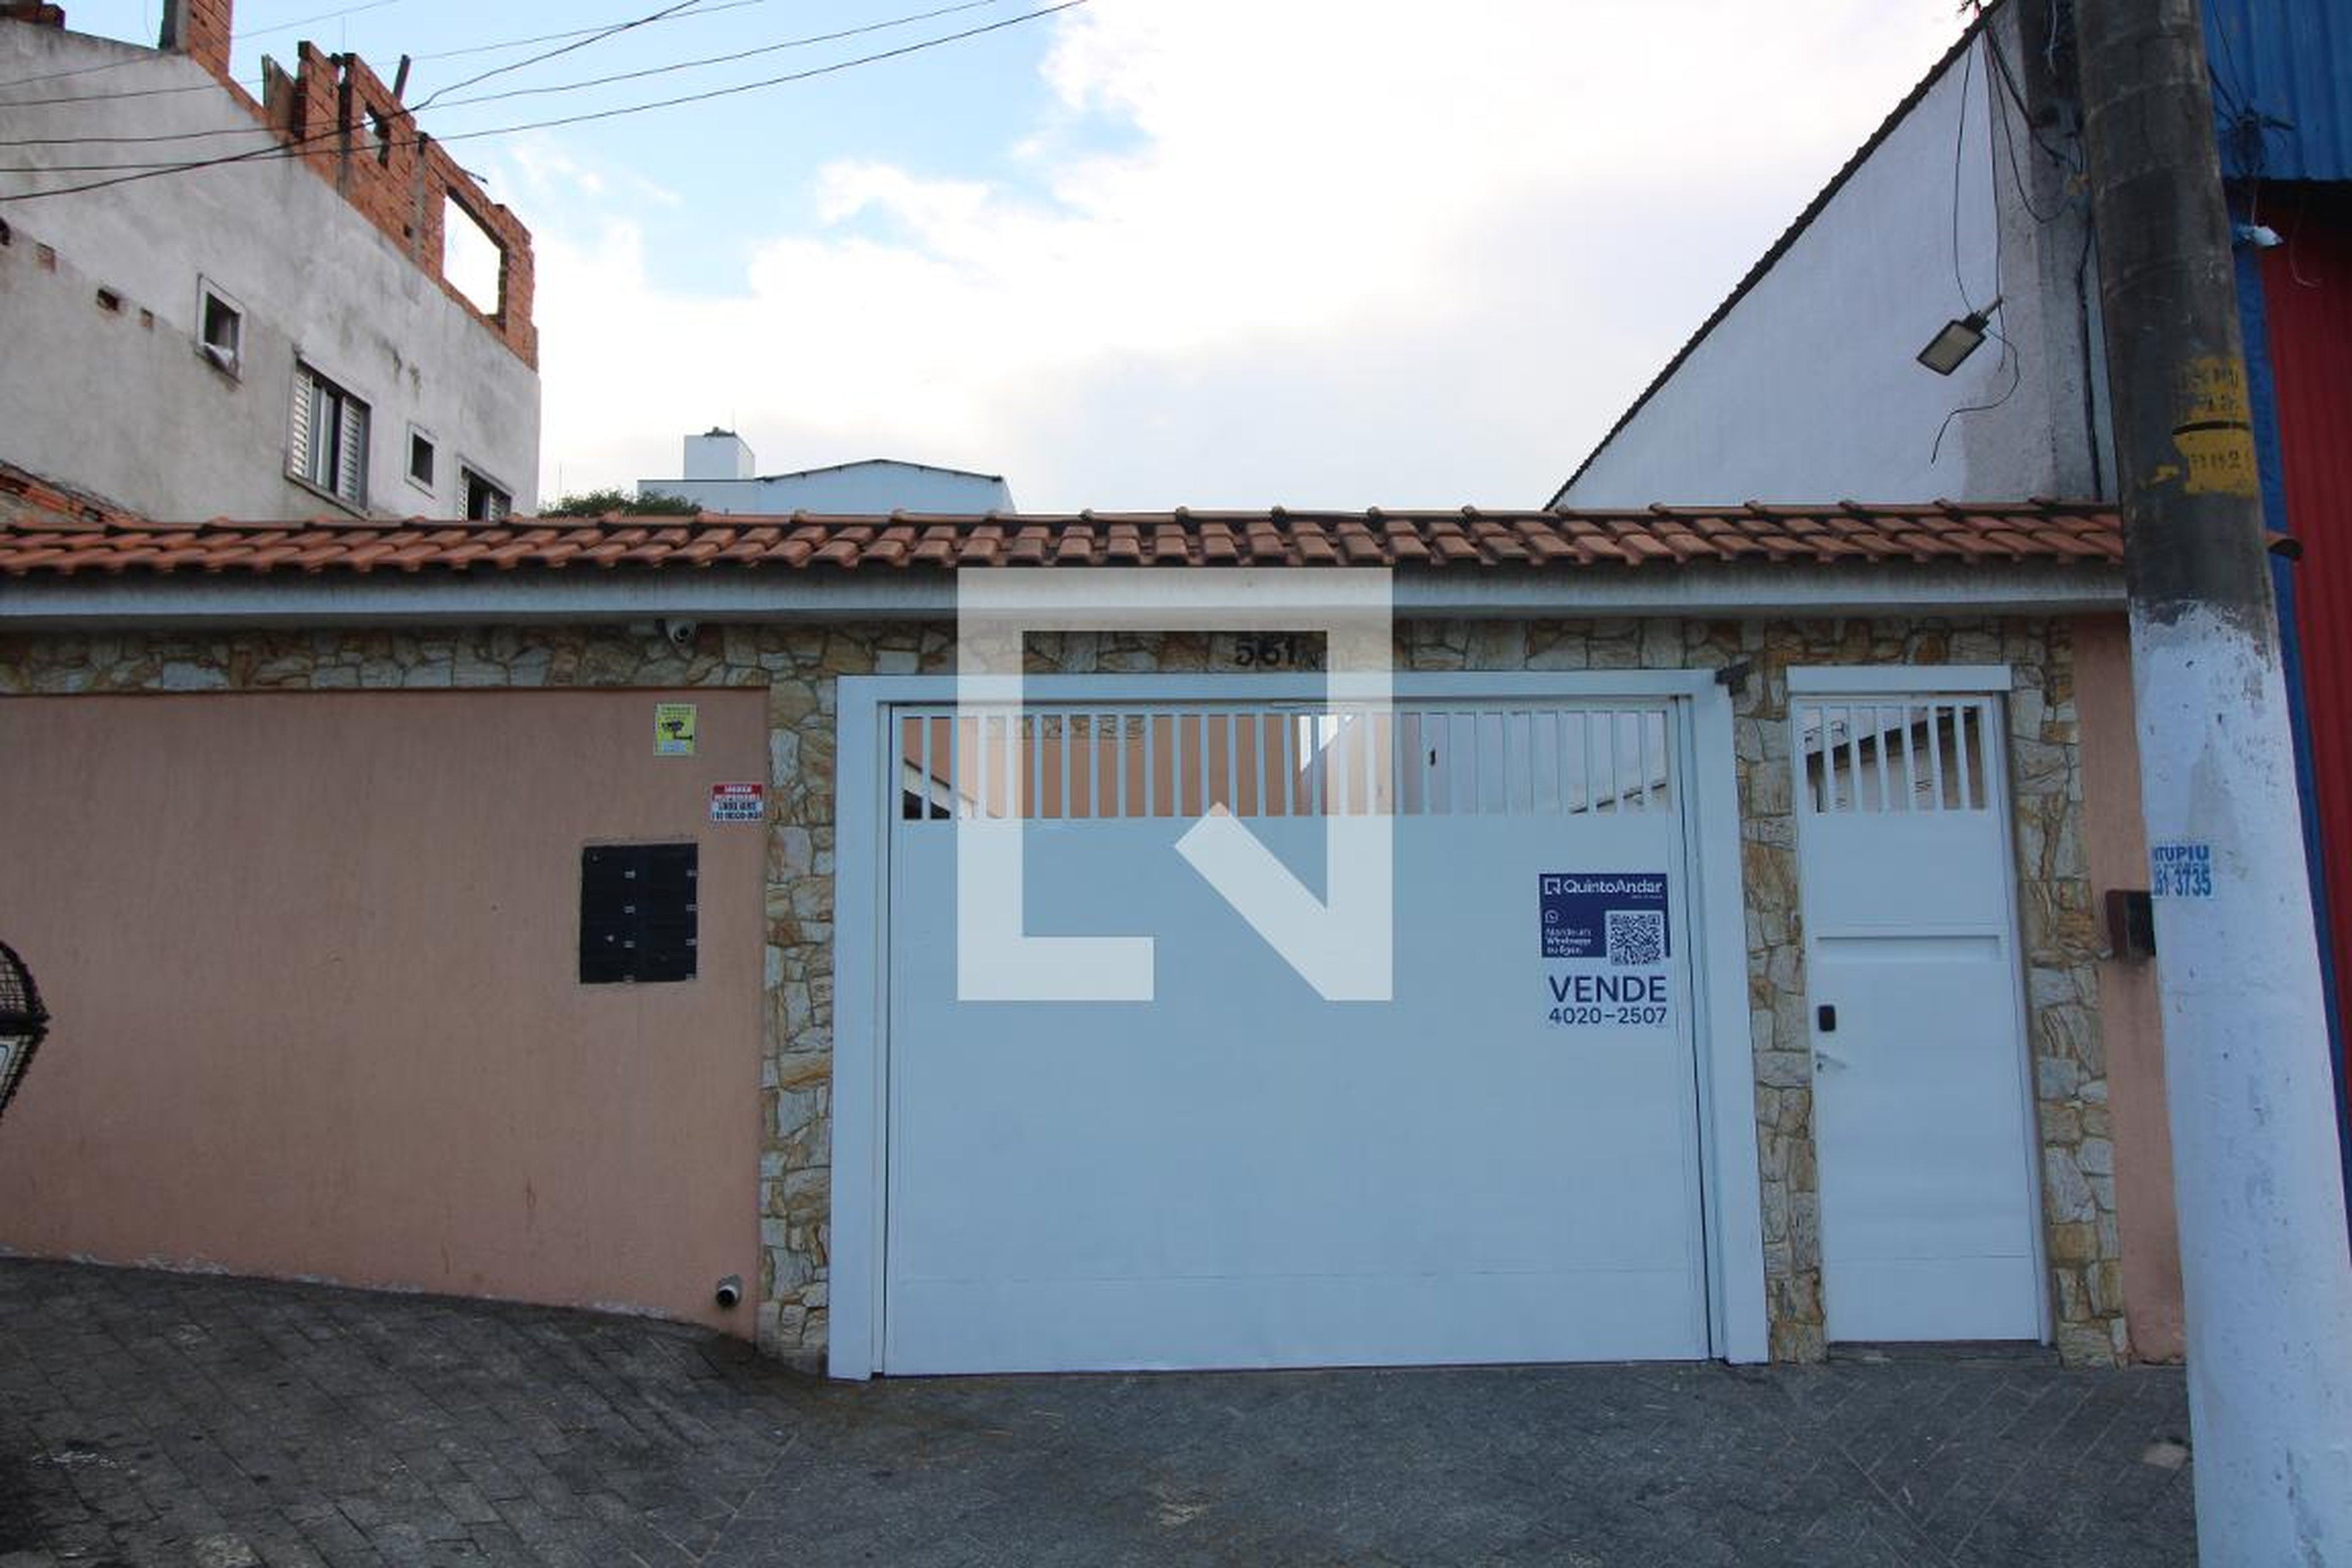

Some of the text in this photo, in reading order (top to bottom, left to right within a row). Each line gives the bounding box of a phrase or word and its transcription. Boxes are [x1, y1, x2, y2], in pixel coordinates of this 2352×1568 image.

[1564, 879, 1663, 894] QuintoAndar
[2174, 867, 2212, 897] 3735
[1549, 976, 1667, 1003] VENDE
[1548, 1008, 1667, 1024] 4020-2507
